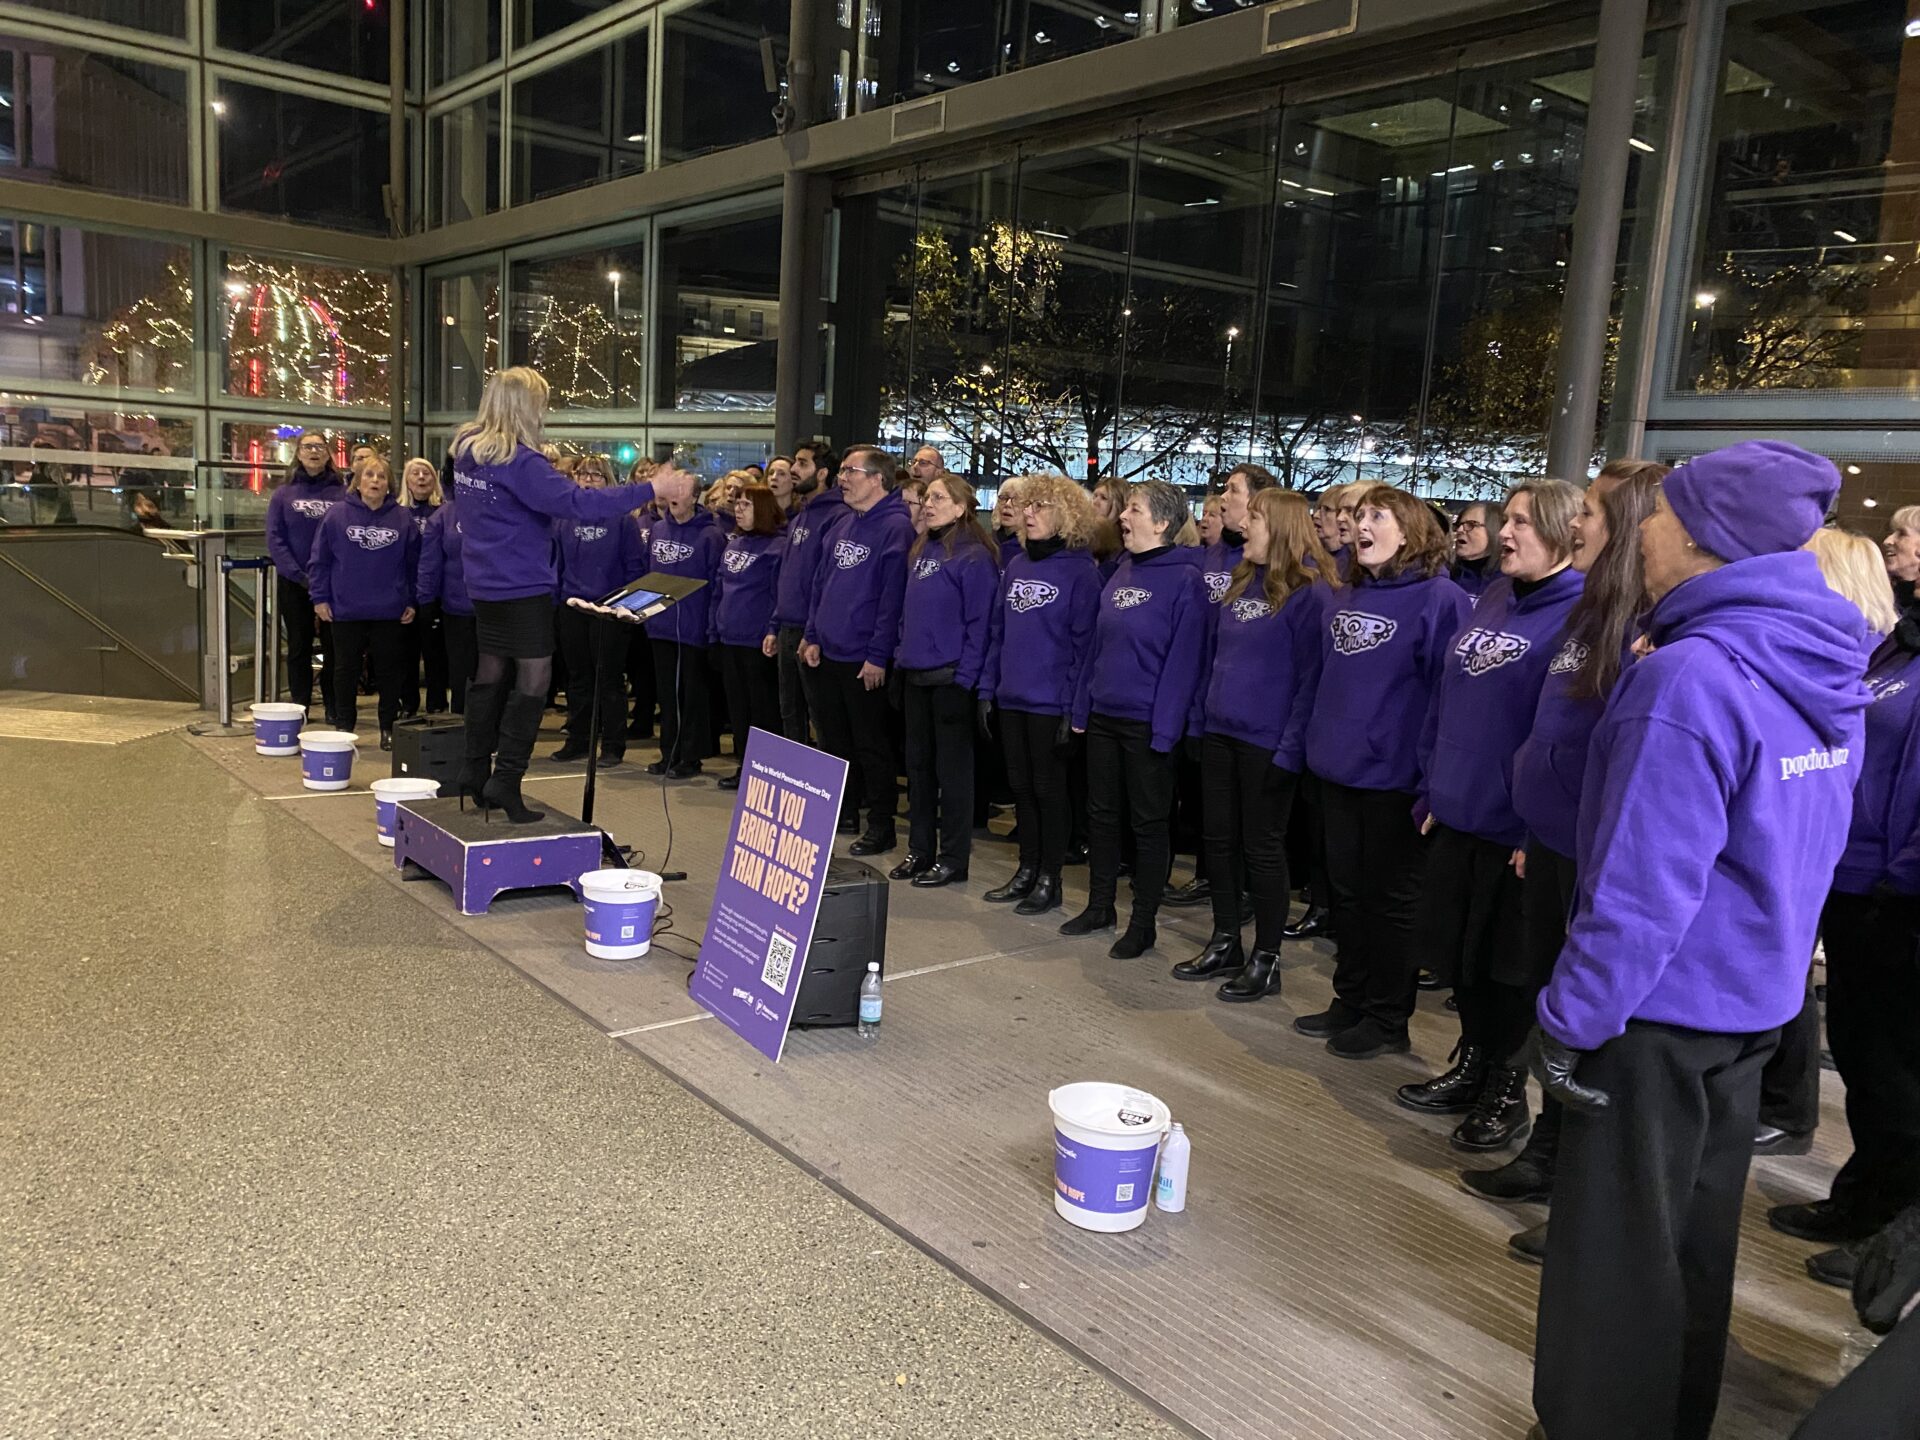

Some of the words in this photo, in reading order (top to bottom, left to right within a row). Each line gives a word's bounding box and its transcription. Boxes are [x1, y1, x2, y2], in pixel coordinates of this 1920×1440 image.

[351, 528, 393, 540] POP
[655, 541, 688, 554] POP
[1008, 581, 1050, 600] POP
[1115, 589, 1146, 601] POP
[1236, 601, 1269, 614] POP
[1335, 614, 1387, 637] POP
[751, 760, 764, 774] Today
[768, 767, 781, 780] World
[780, 772, 805, 789] Pancreatic
[804, 782, 822, 796] Cancer
[820, 788, 832, 801] Day
[745, 775, 776, 819] WILL
[777, 788, 807, 831] YOU
[736, 810, 778, 859] BRING
[775, 828, 819, 880] MORE
[729, 844, 766, 892] THAN
[762, 862, 810, 915] HOPE?
[1120, 1113, 1145, 1124] SEAL
[1068, 1186, 1086, 1203] HOPE
